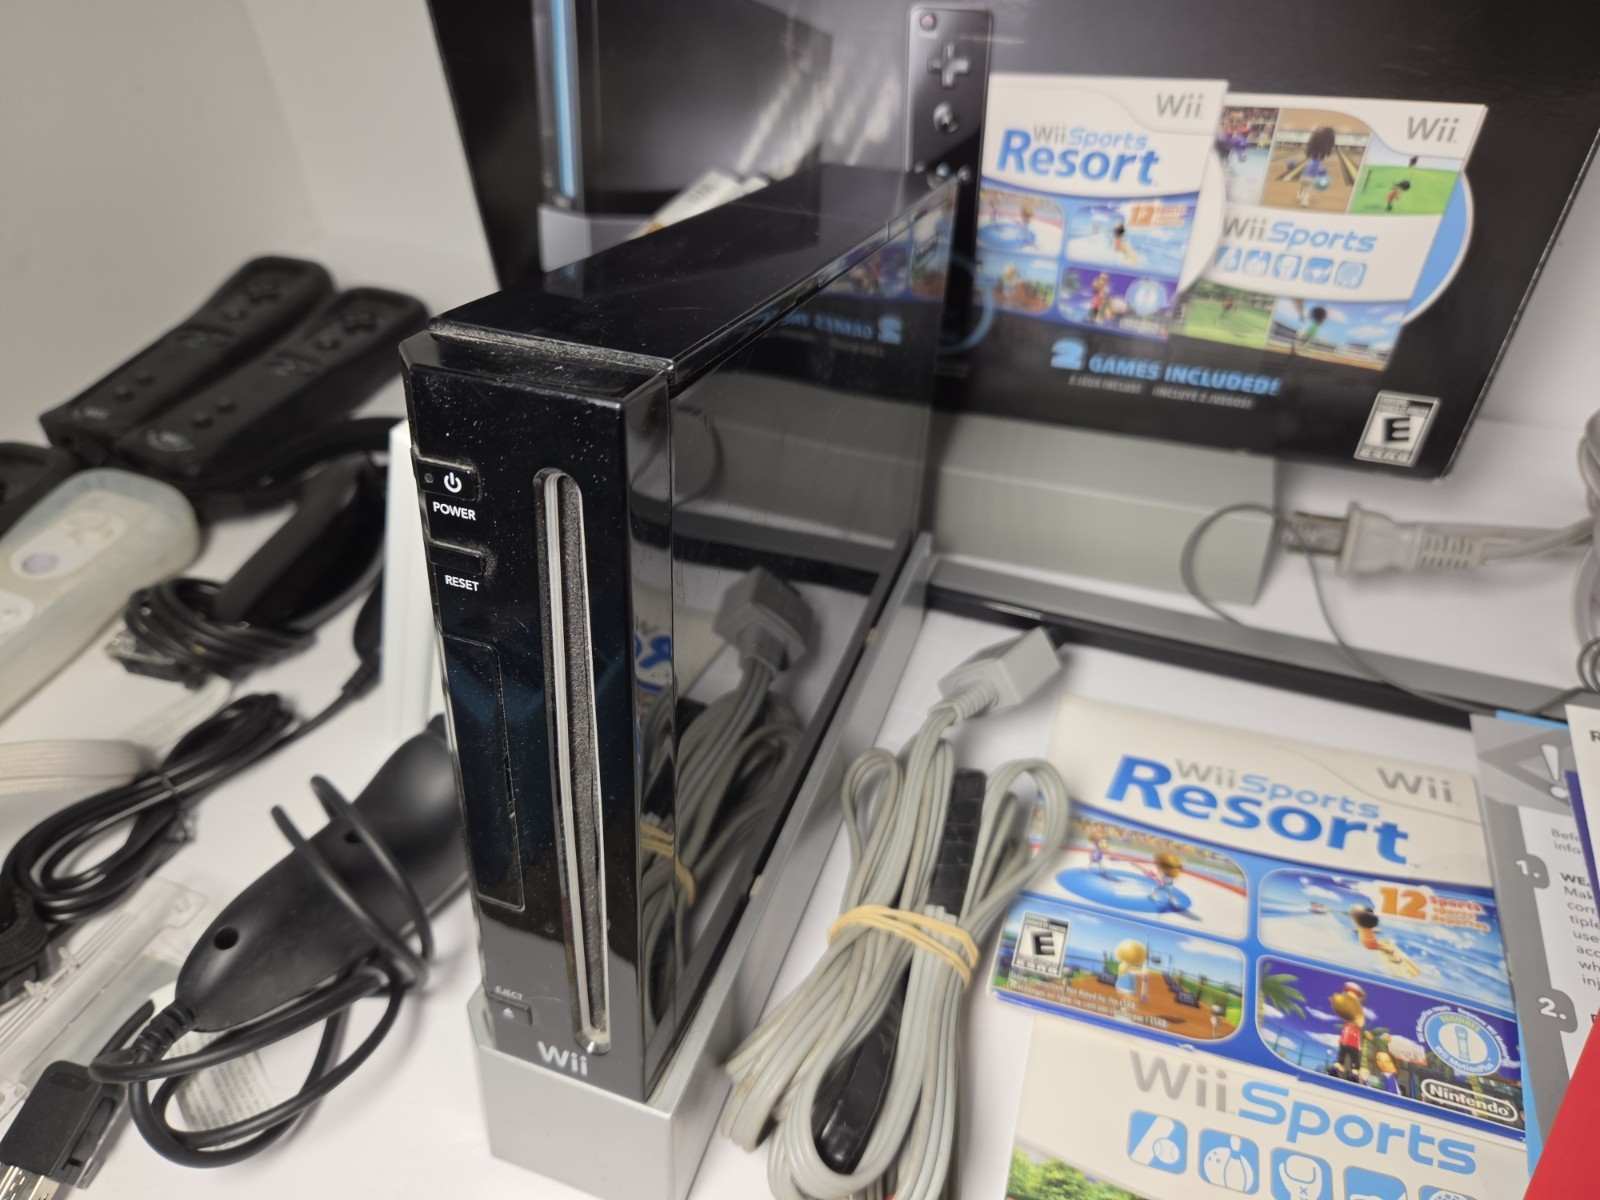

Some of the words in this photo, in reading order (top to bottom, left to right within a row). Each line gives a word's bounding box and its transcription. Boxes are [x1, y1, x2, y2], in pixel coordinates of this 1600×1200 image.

[1155, 94, 1203, 120] Wii
[1033, 123, 1067, 145] Wii
[1068, 127, 1149, 151] Sports
[1407, 116, 1460, 142] Wii
[996, 129, 1160, 187] Resort
[1222, 217, 1265, 241] Wii
[1268, 222, 1378, 253] Sports
[1050, 337, 1086, 370] 2
[1088, 354, 1160, 381] GAMES
[1163, 364, 1283, 396] INCLUDED!
[1384, 417, 1411, 443] E
[432, 501, 476, 521] POWER
[444, 574, 480, 592] RESET
[1174, 758, 1237, 790] Wii
[1238, 772, 1381, 820] Sports
[1376, 766, 1454, 804] Wii
[1105, 753, 1409, 866] Resort
[1515, 859, 1541, 879] 1.
[1379, 887, 1428, 920] 12
[1032, 931, 1056, 956] E
[1538, 997, 1568, 1020] 2.
[537, 1040, 588, 1077] Wii
[1129, 1048, 1228, 1114] Wii
[1238, 1080, 1477, 1176] Sports
[1429, 1083, 1509, 1116] Nintendo
